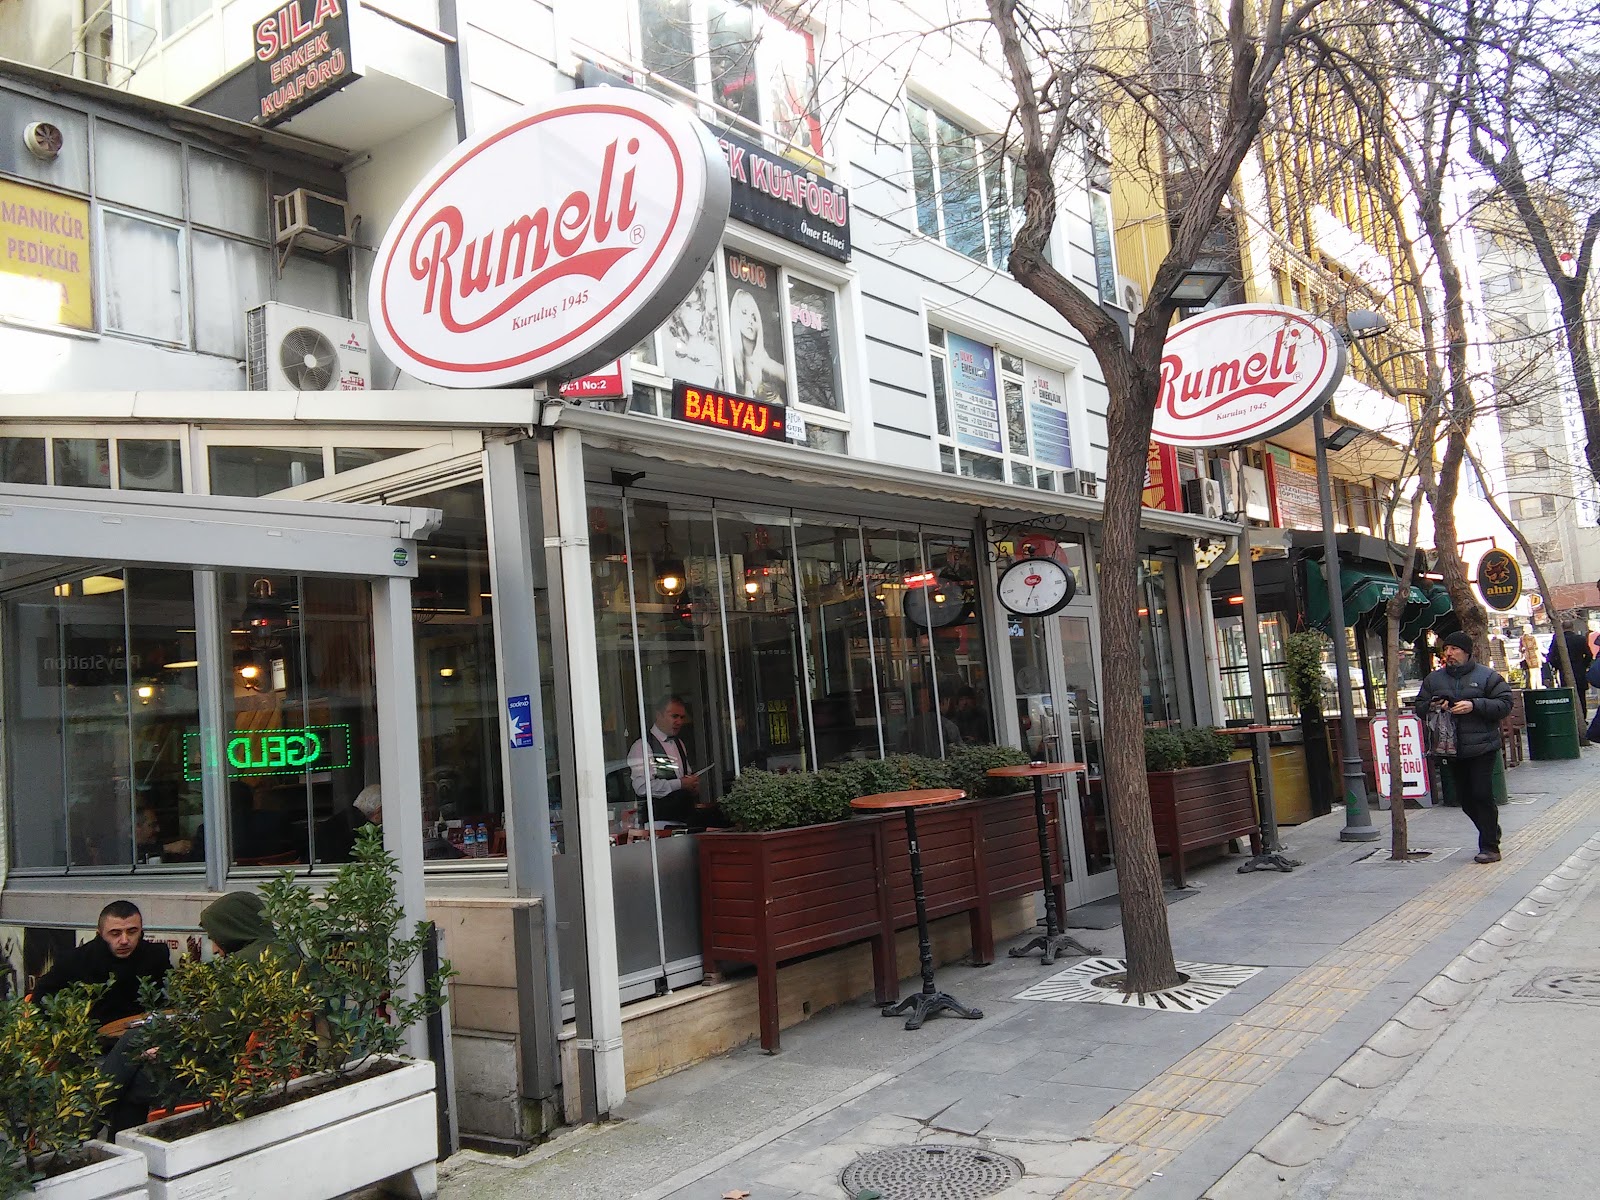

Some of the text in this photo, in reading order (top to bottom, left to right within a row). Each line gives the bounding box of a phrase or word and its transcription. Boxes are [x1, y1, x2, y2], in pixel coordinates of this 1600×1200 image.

[257, 0, 342, 61] SILA
[270, 31, 331, 85] ERKEK
[260, 48, 345, 117] KUAFÖRÜ
[750, 153, 847, 228] KUAFÖRÜ
[1, 200, 84, 240] MANİKÜR
[410, 136, 640, 334] Rumeli
[800, 219, 846, 251] Ömer Ekinci
[7, 236, 81, 273] PEDİKÜR
[729, 255, 767, 289] UĞUR
[512, 289, 590, 332] Kuruluş 1945
[582, 380, 607, 390] No:2
[1155, 328, 1300, 420] Rumeli
[685, 389, 768, 433] BALYAJ
[1216, 402, 1268, 421] Kuruluş 1945
